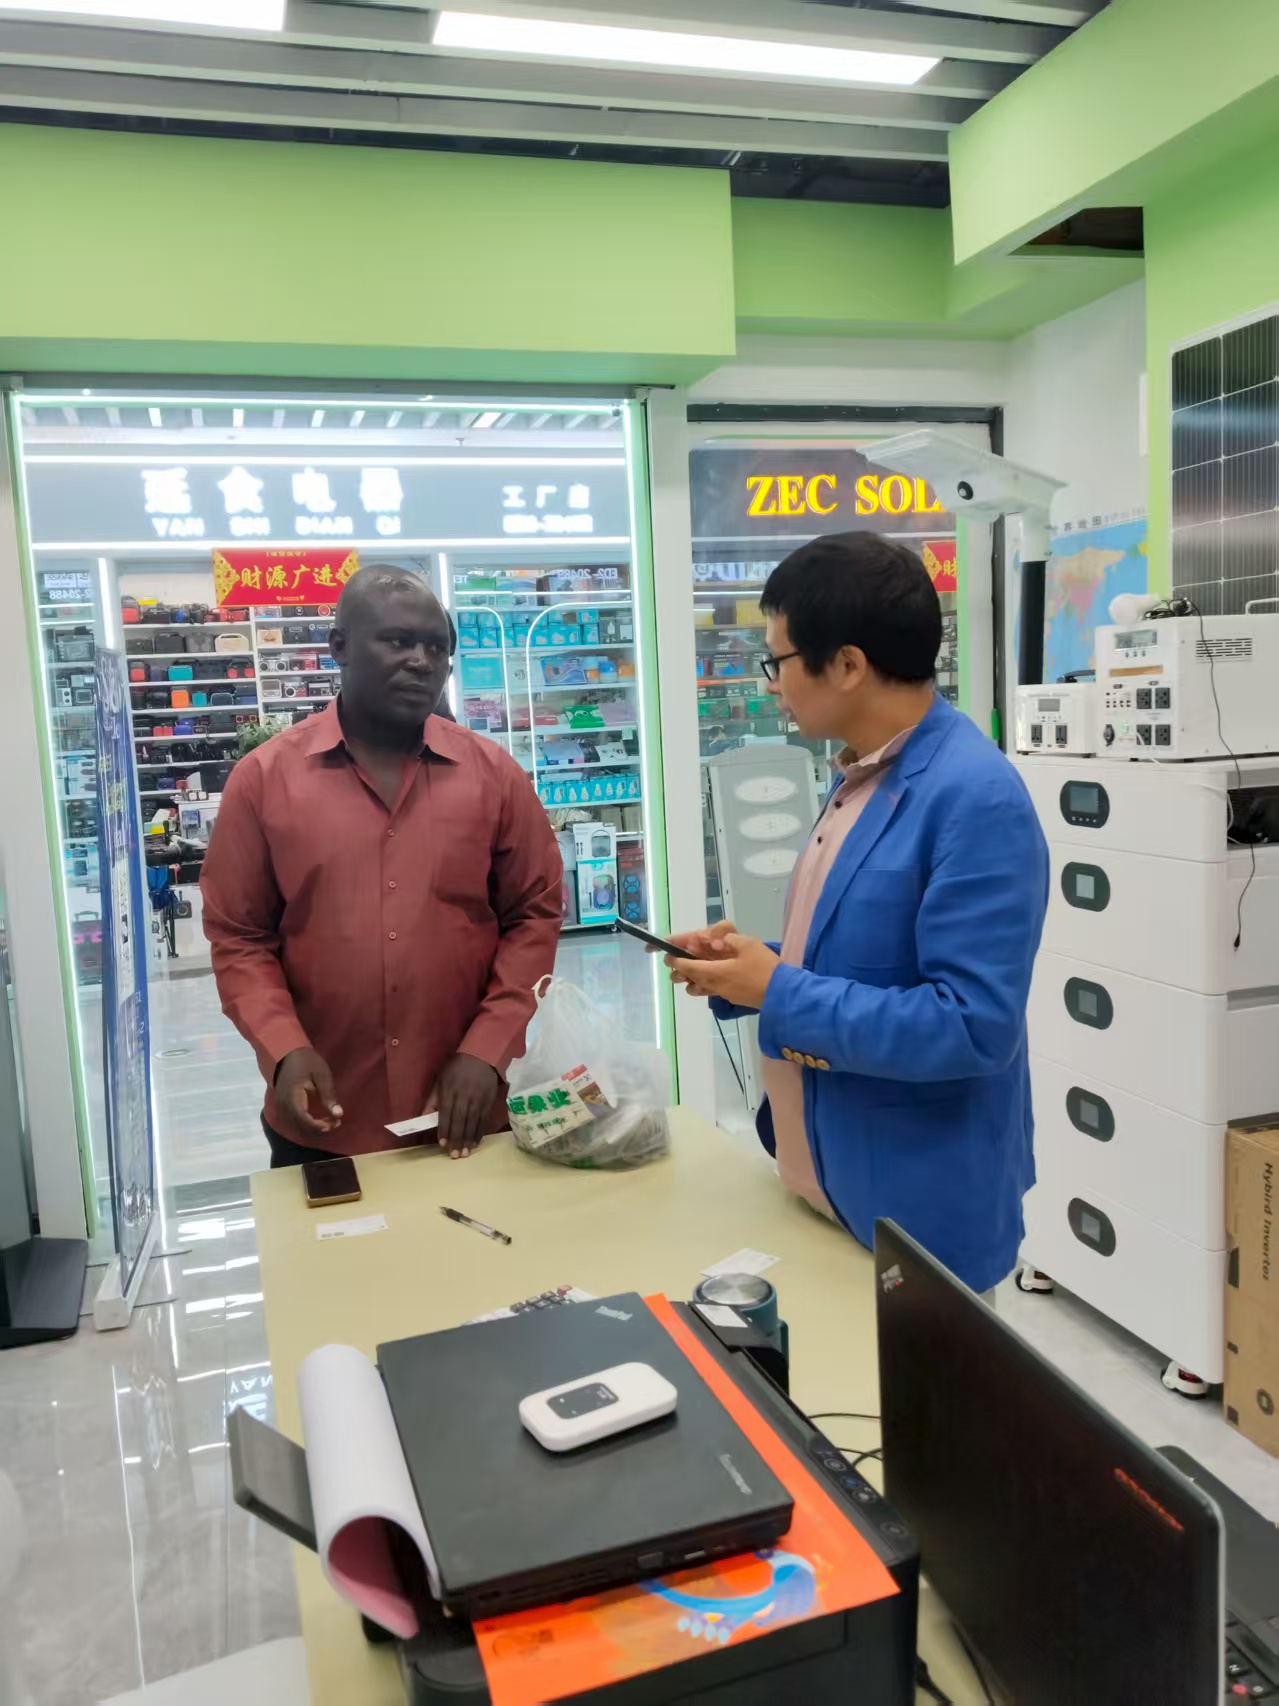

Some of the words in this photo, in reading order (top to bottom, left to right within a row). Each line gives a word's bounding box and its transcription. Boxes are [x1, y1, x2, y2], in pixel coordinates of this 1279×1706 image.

[746, 473, 837, 516] ZEC
[855, 473, 946, 515] SOL
[240, 563, 337, 590] 财源广进
[1262, 1162, 1274, 1216] Hybird
[1261, 1219, 1273, 1281] Inverter
